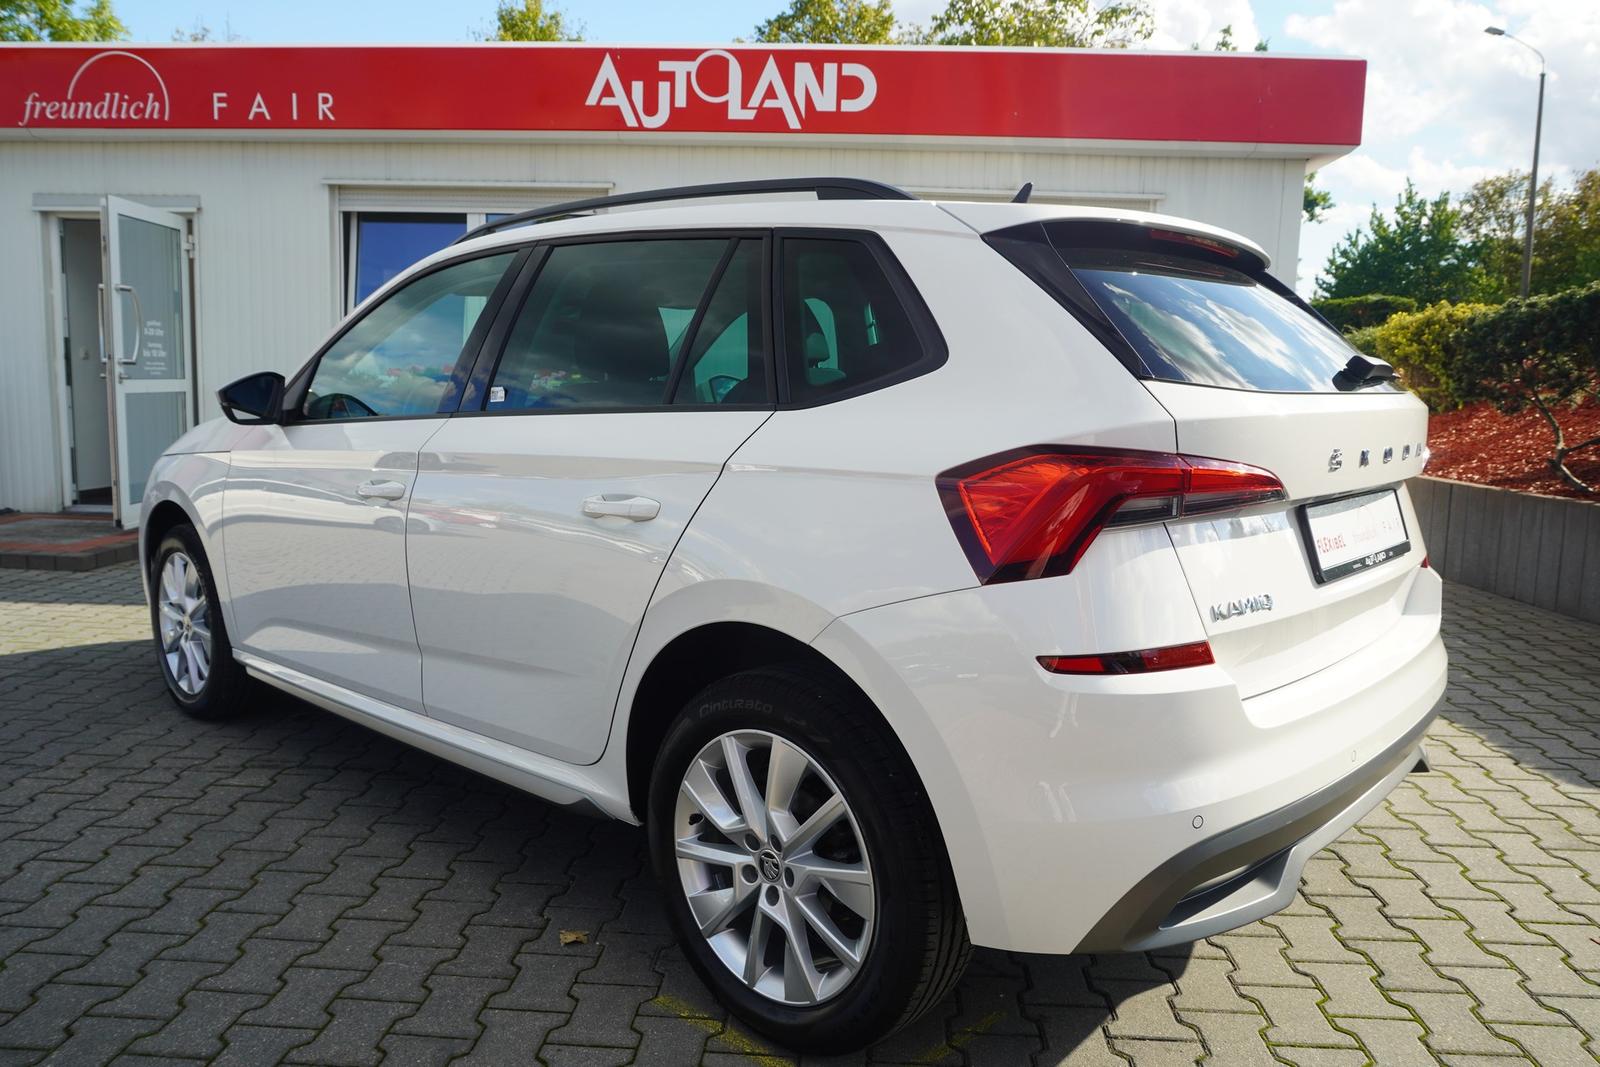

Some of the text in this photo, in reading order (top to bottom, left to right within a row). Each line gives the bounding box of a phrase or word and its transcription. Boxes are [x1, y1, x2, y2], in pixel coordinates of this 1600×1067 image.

[584, 49, 878, 130] AUTOLAND
[18, 92, 336, 127] freundlich FAIR
[1209, 593, 1273, 623] KAMIQ
